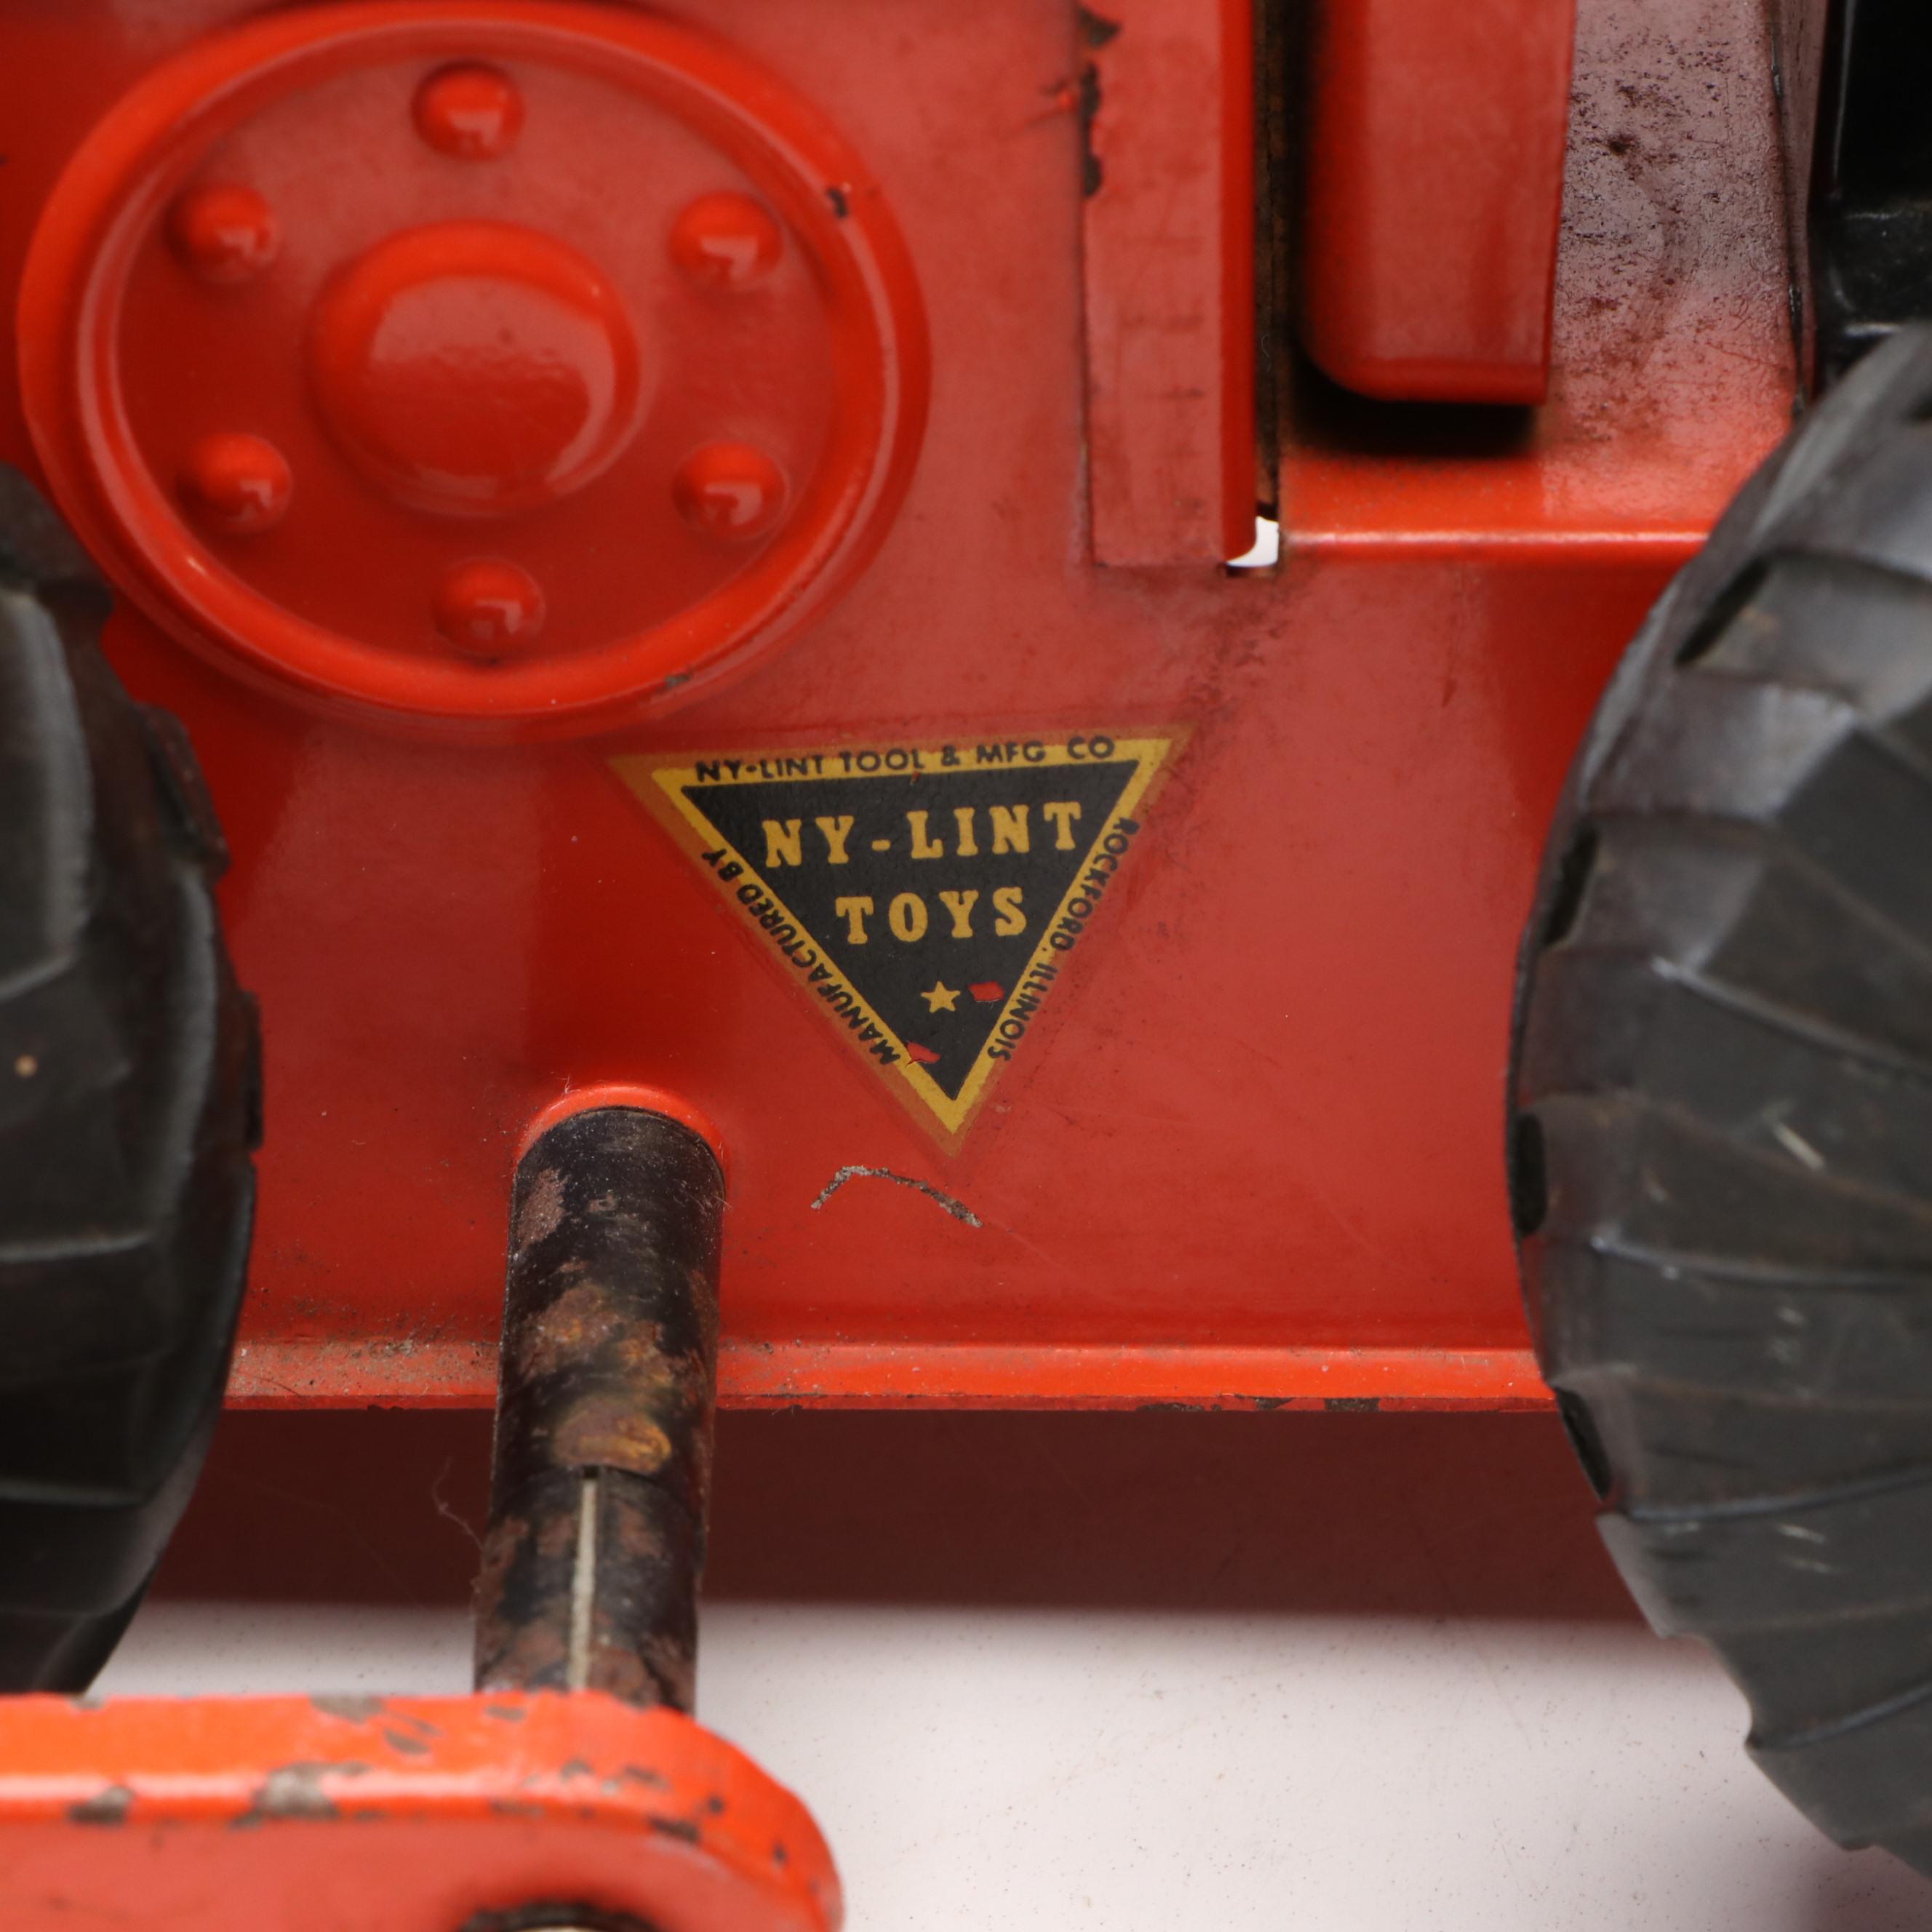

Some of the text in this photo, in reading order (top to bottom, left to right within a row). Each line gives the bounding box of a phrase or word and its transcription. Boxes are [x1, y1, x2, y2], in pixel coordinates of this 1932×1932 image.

[696, 735, 1115, 783] NY-LINT TOOL & MFG CO
[836, 887, 1028, 945] TOYS
[701, 849, 901, 1065] MANUFACTURED BY
[987, 962, 1058, 1061] ILLINOIS
